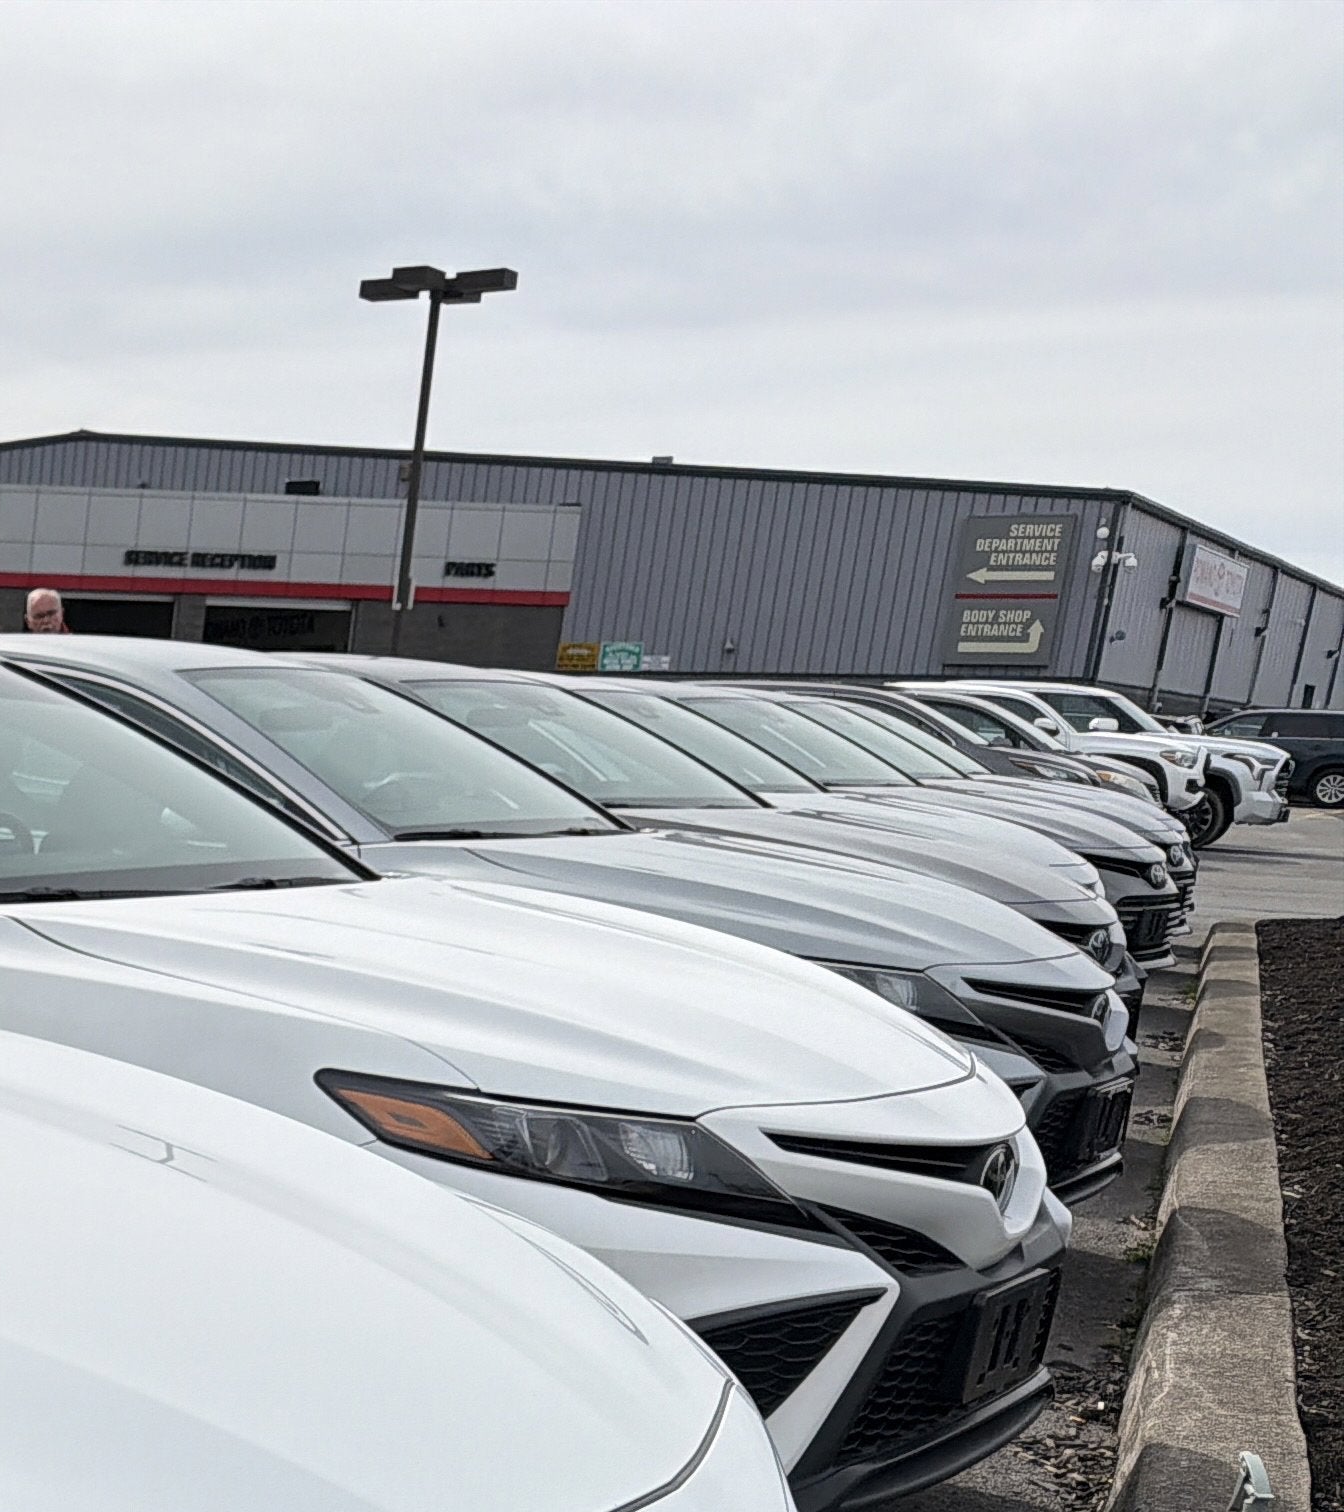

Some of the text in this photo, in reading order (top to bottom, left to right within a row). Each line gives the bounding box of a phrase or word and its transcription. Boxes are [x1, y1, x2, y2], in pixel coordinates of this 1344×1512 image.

[1009, 524, 1063, 537] SERVICE
[975, 538, 1061, 552] DEPARTMENT
[124, 550, 277, 570] SERVICE RECEPTION
[989, 552, 1058, 566] ENTRANCE
[444, 561, 497, 578] PARTS
[962, 609, 1032, 623] BODY SHOP
[960, 624, 1024, 637] ENTRANCE
